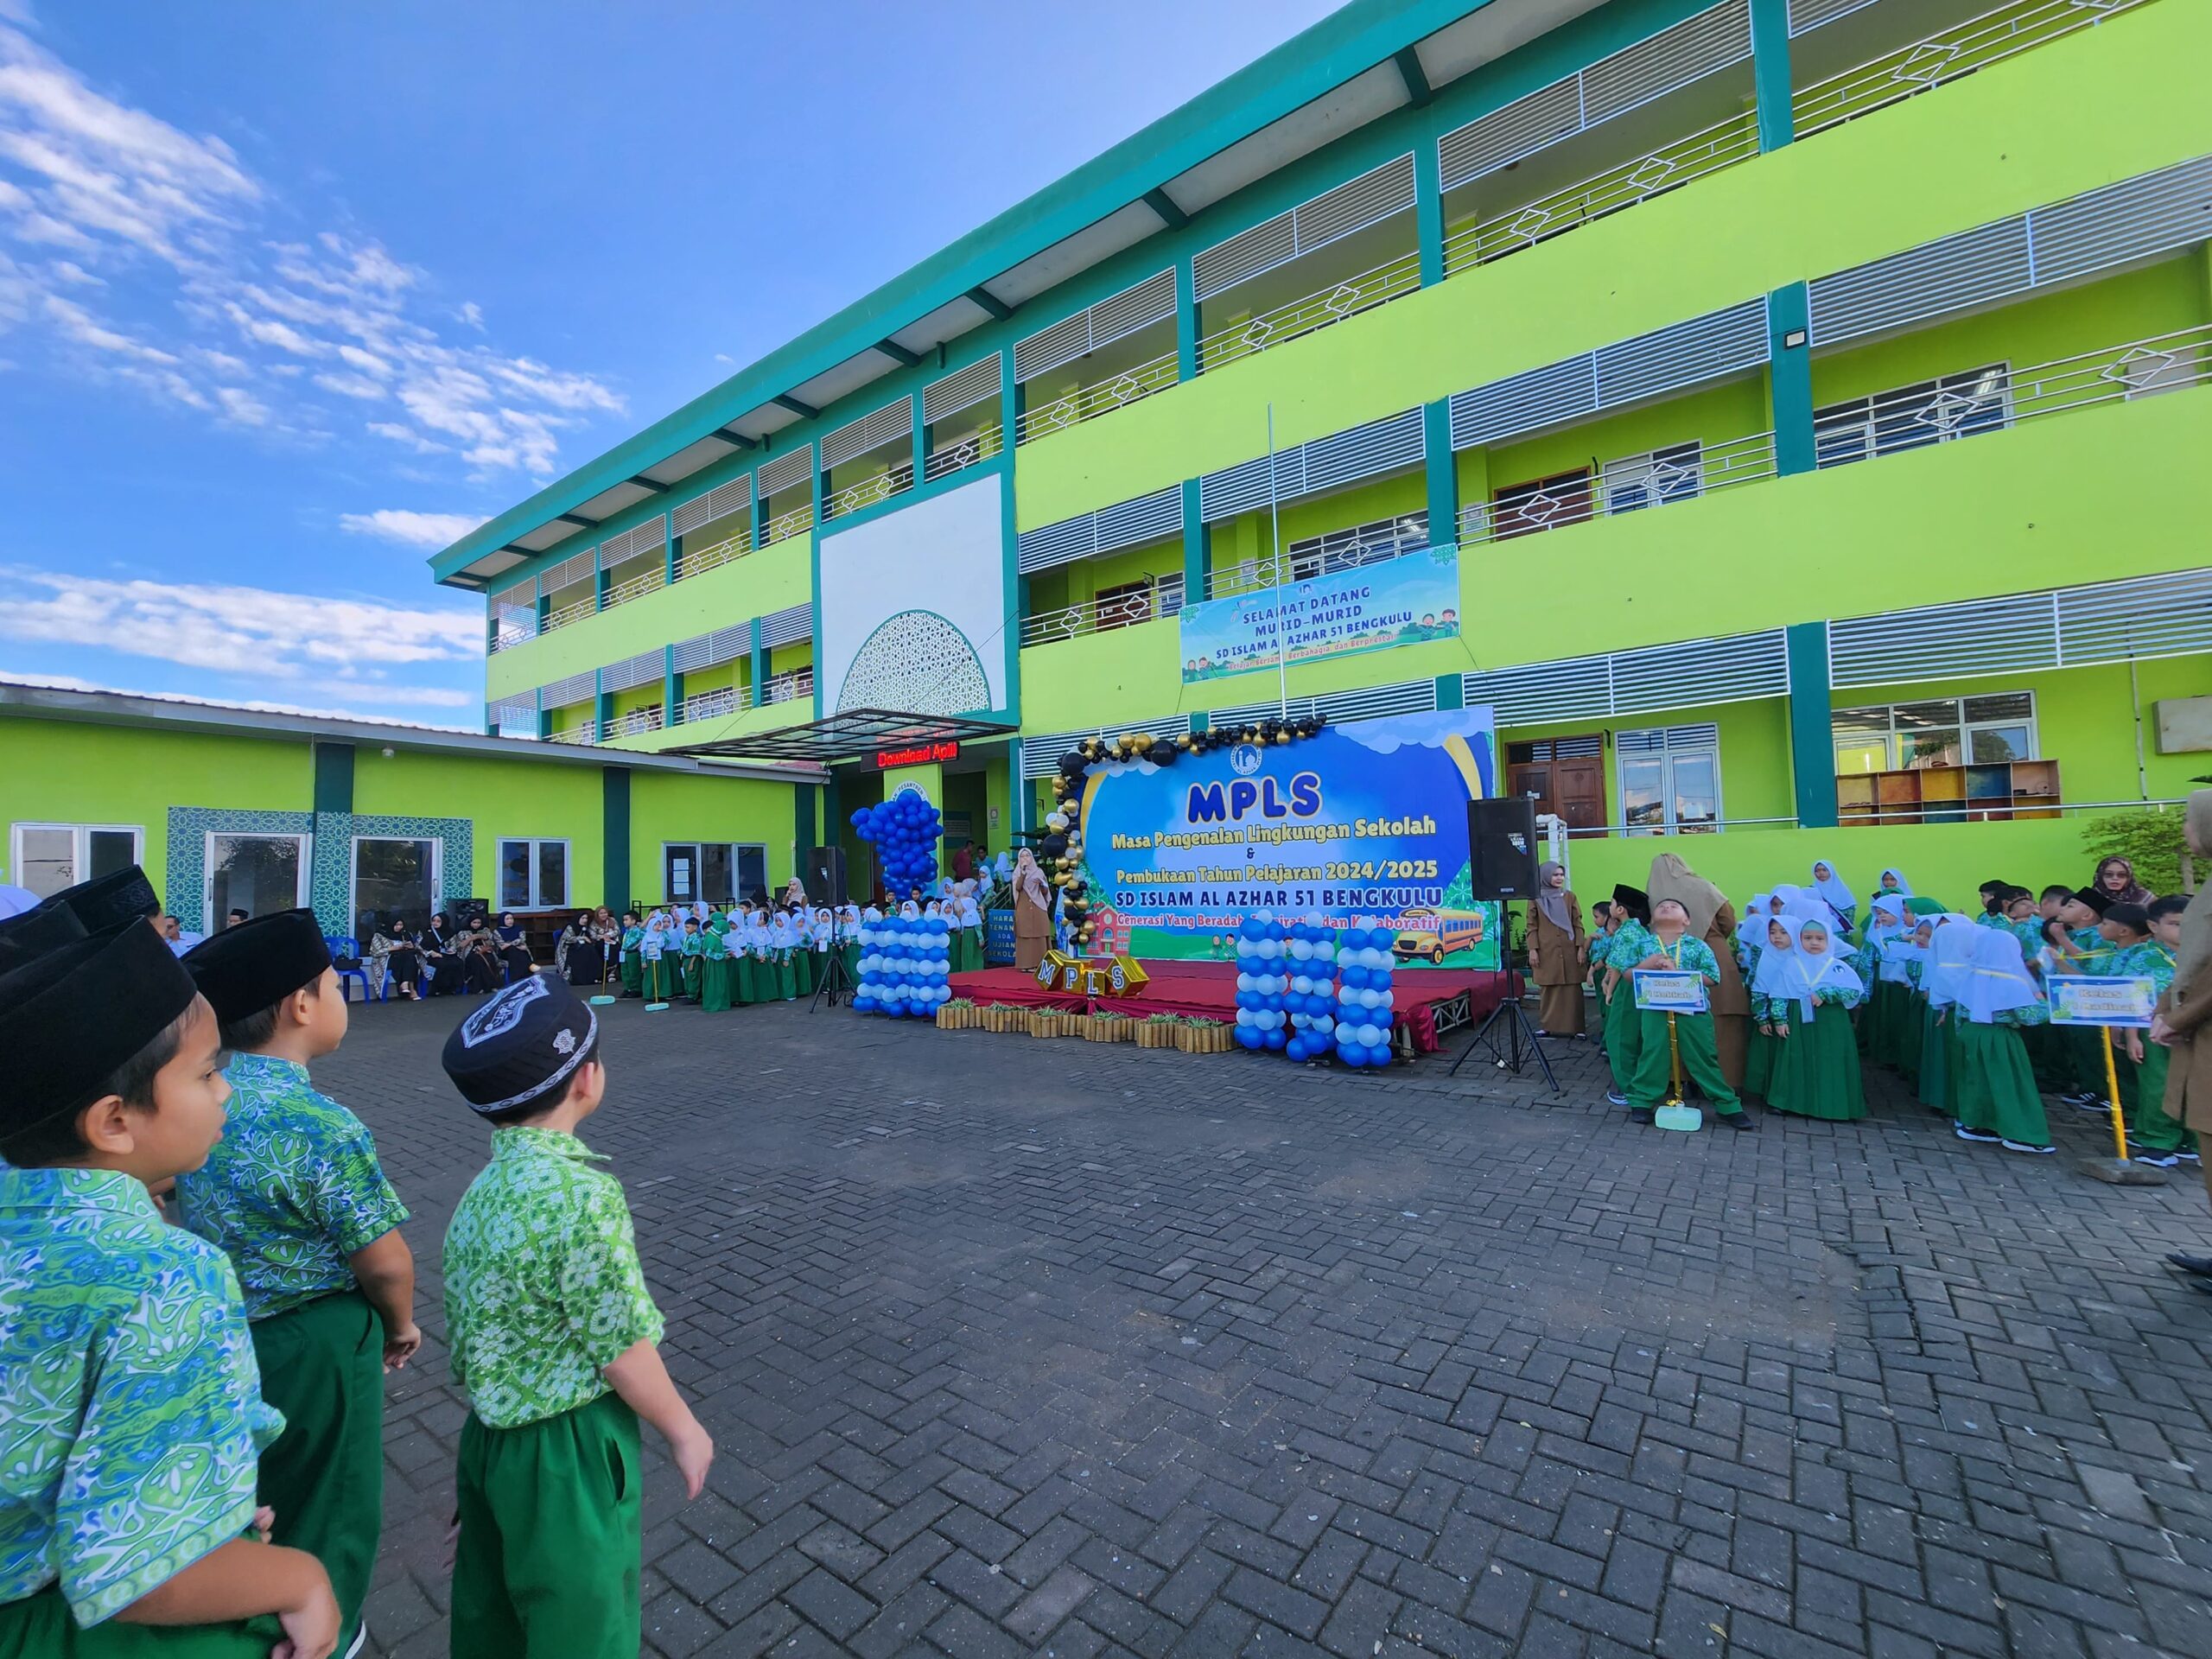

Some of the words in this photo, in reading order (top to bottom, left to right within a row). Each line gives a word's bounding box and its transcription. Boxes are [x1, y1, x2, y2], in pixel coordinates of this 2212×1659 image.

[1243, 601, 1306, 625] SELAMAT
[1310, 586, 1370, 610] DATANG
[1215, 648, 1230, 659] SD
[1231, 639, 1268, 657] ISLAM
[1287, 628, 1328, 646] AZHAR
[1331, 626, 1343, 638] 51
[1346, 611, 1413, 633] BENGKULU
[1334, 642, 1348, 651] dan
[877, 745, 931, 767] Download
[1187, 772, 1322, 823] MPLS
[1112, 833, 1152, 849] Masa
[1154, 827, 1244, 850] Pengenalan
[1246, 823, 1350, 846] Lingkungan
[1354, 815, 1436, 837] Sekolah
[1246, 847, 1255, 860] &
[1116, 867, 1196, 884] Pembukaan
[1198, 866, 1243, 882] Tahun
[1245, 863, 1322, 885] Pelajaran
[1325, 859, 1439, 881] 2024/2025
[1116, 892, 1135, 906] SD
[1140, 891, 1193, 906] ISLAM
[1200, 891, 1220, 906] AL
[1226, 890, 1287, 906] AZHAR
[1295, 890, 1315, 906] 51
[1322, 887, 1442, 907] BENGKULU
[1117, 913, 1164, 926] Generasi
[1166, 914, 1195, 929] Yang
[1322, 915, 1347, 928] dan
[1352, 914, 1440, 930] Kaboratif
